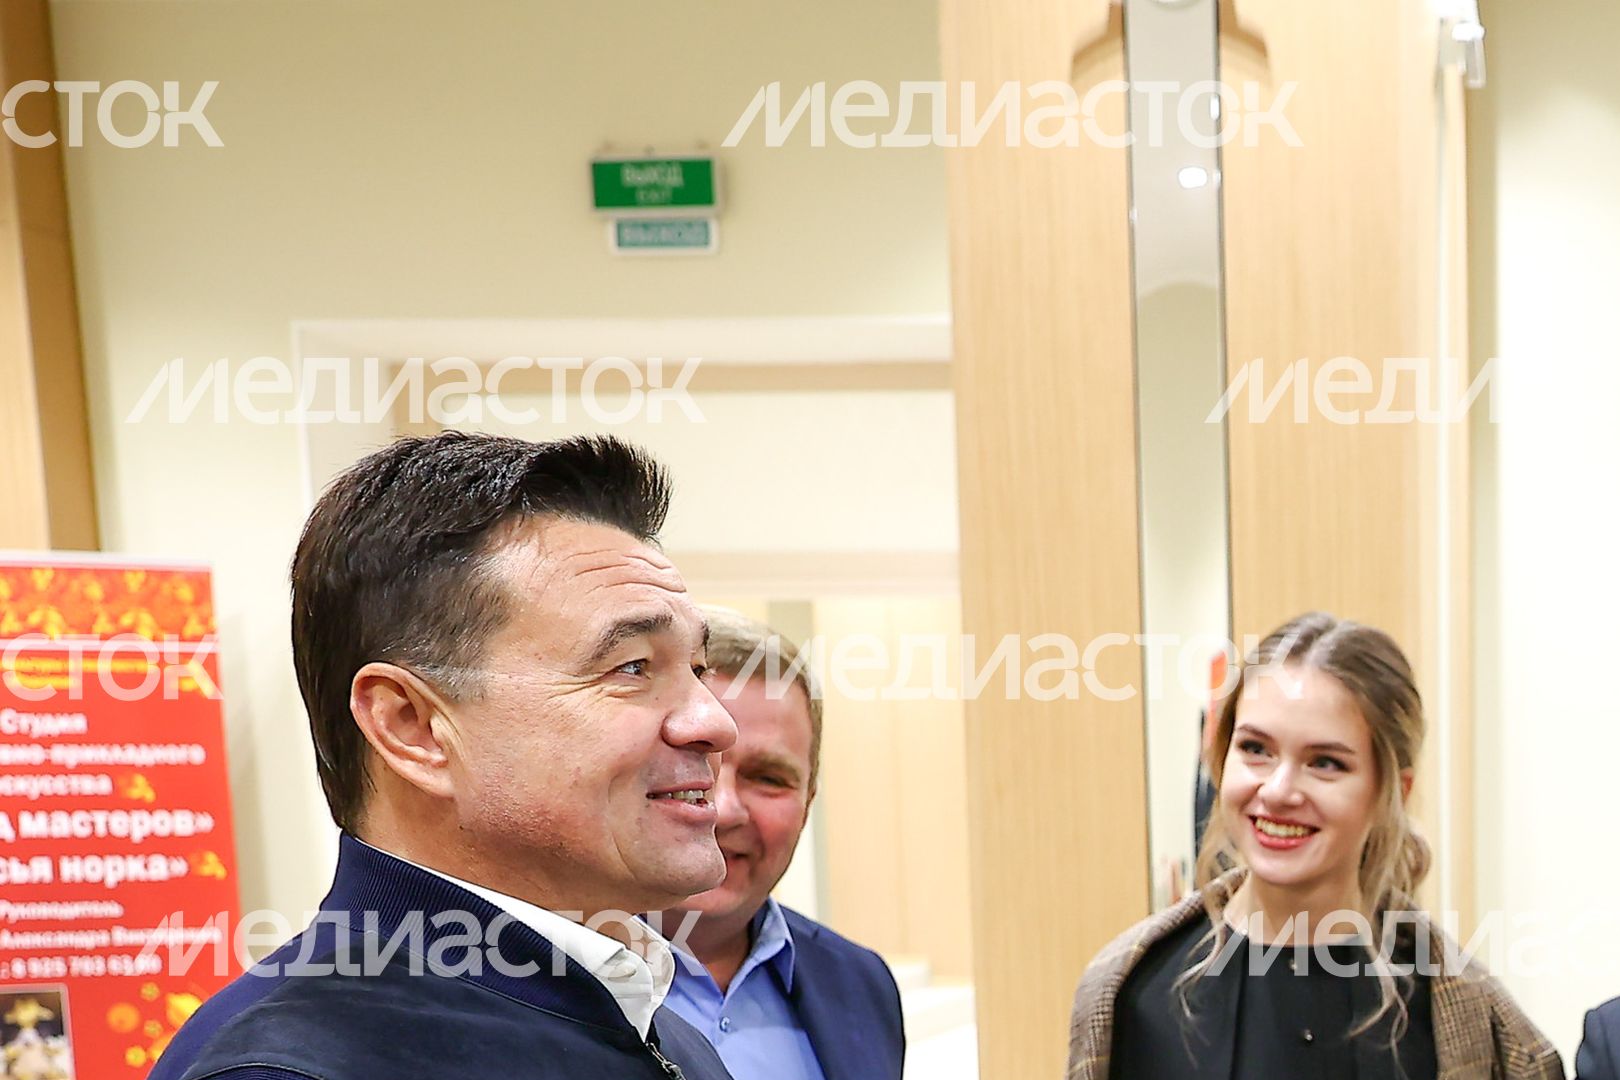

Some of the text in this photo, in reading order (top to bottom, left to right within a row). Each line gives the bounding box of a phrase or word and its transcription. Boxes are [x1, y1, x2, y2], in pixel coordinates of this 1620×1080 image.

[1, 708, 87, 738] Студия
[18, 810, 214, 843] мастеров»
[59, 853, 188, 888] норка»
